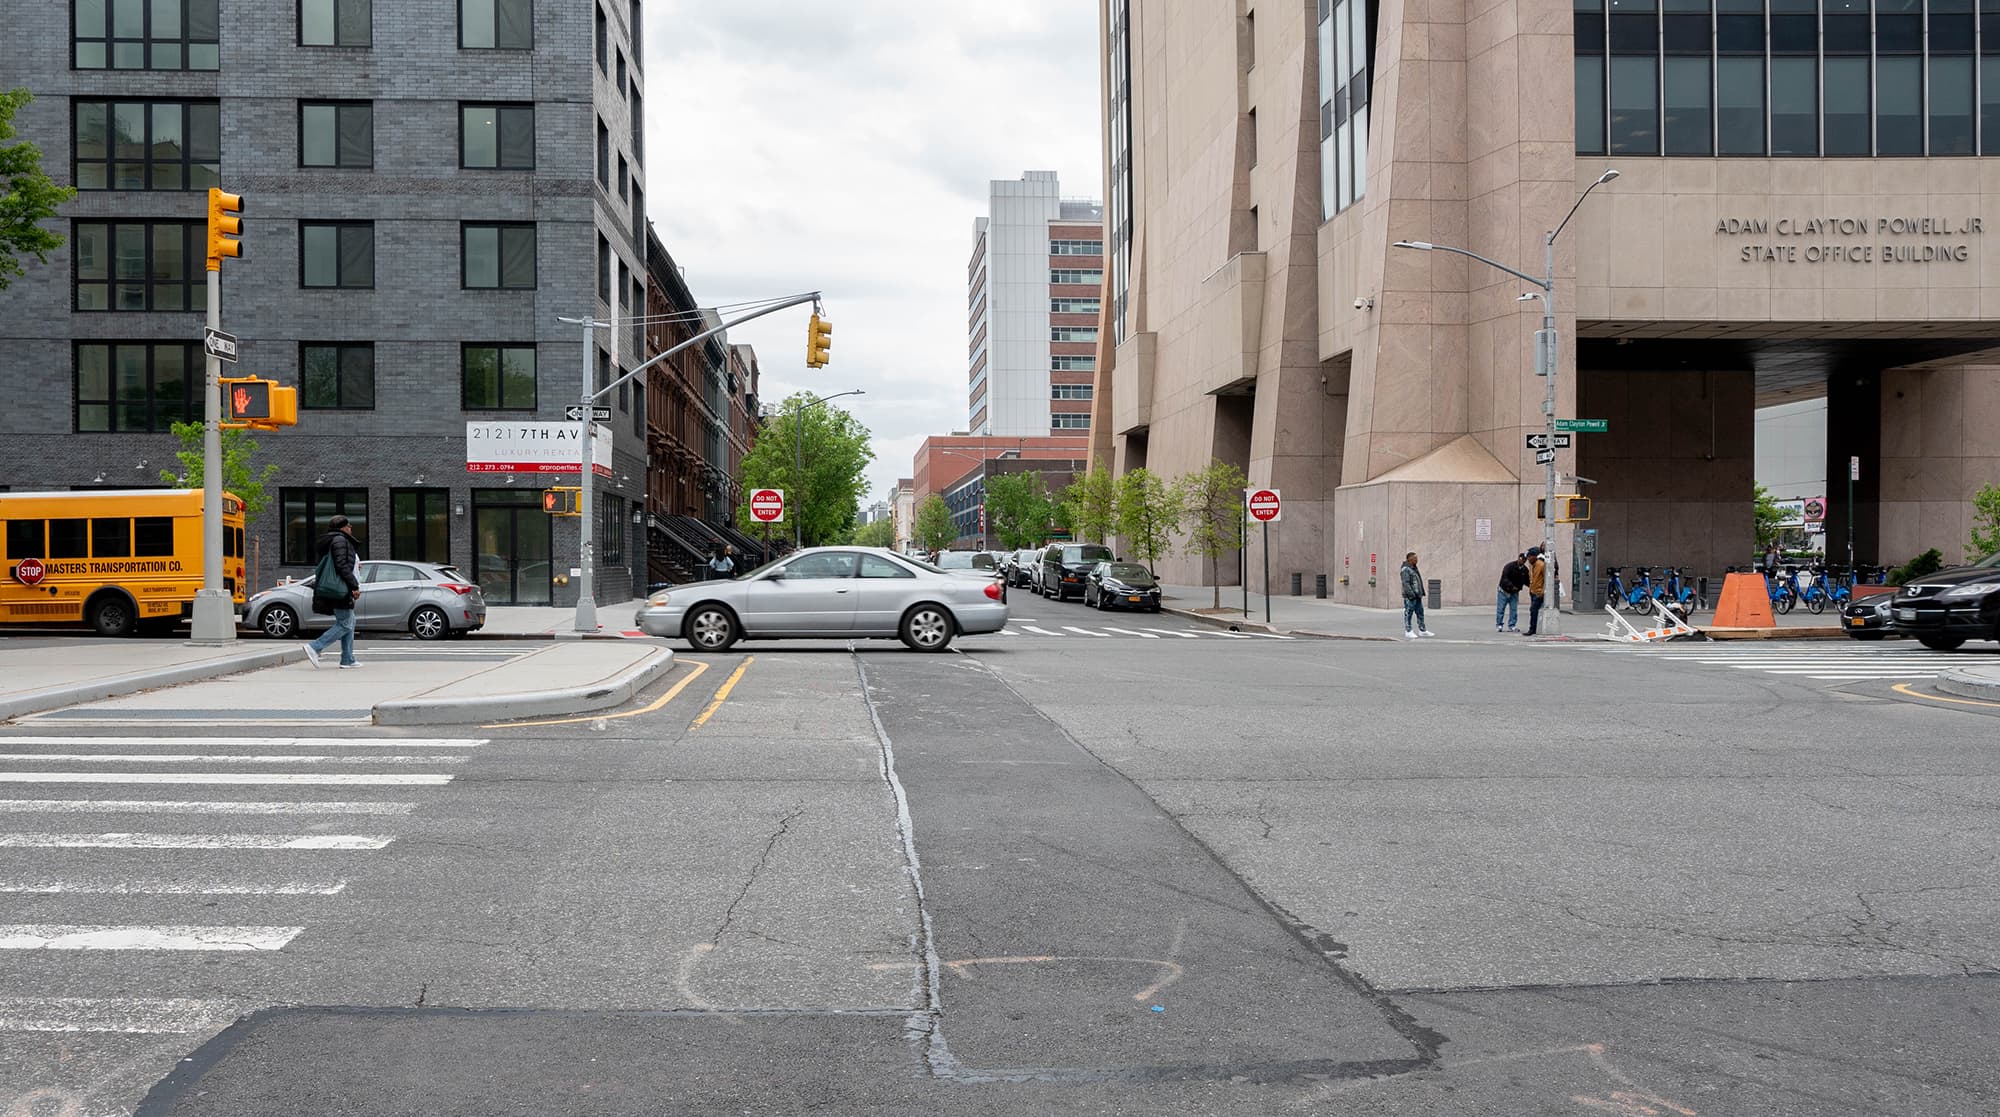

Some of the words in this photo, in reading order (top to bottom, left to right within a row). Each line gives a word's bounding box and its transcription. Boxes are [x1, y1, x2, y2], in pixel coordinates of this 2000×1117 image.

[1715, 217, 1768, 234] ADAM
[1776, 217, 1868, 236] CLAYTON
[1741, 245, 1797, 263] STATE
[1804, 245, 1873, 263] OFFICE
[1881, 244, 1968, 263] BUILDING
[571, 410, 583, 418] ON
[473, 428, 513, 440] 2121
[520, 429, 549, 440] 7TH
[495, 448, 538, 457] LUXURY
[21, 566, 41, 577] STOP
[45, 562, 87, 575] MASTERS
[89, 561, 167, 574] TRANSPORTATION
[168, 560, 183, 572] CO.
